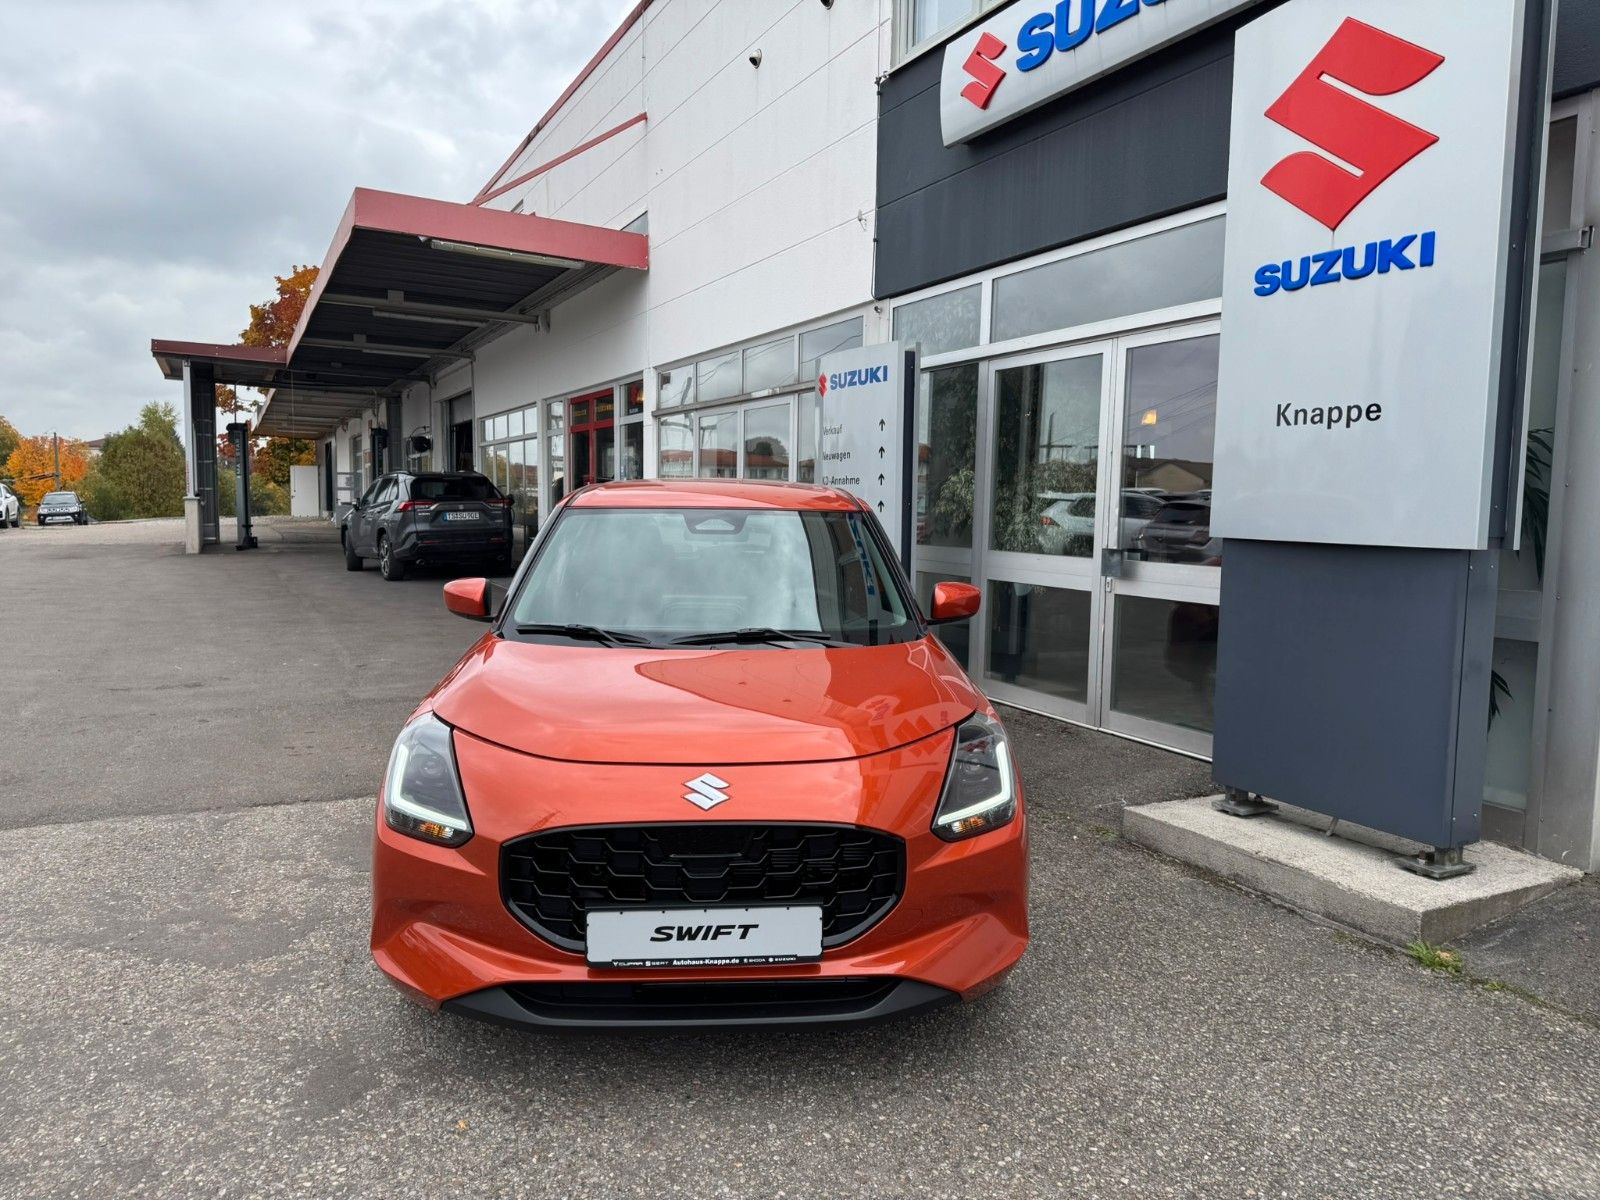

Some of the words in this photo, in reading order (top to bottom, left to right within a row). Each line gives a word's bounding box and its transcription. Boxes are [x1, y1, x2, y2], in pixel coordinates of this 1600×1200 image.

[1253, 230, 1436, 297] SUZUKI
[830, 365, 888, 390] SUZUKI
[1275, 402, 1383, 429] Knappe
[650, 924, 759, 942] SWIFT
[672, 957, 740, 966] Autohaus-Knappe.de
